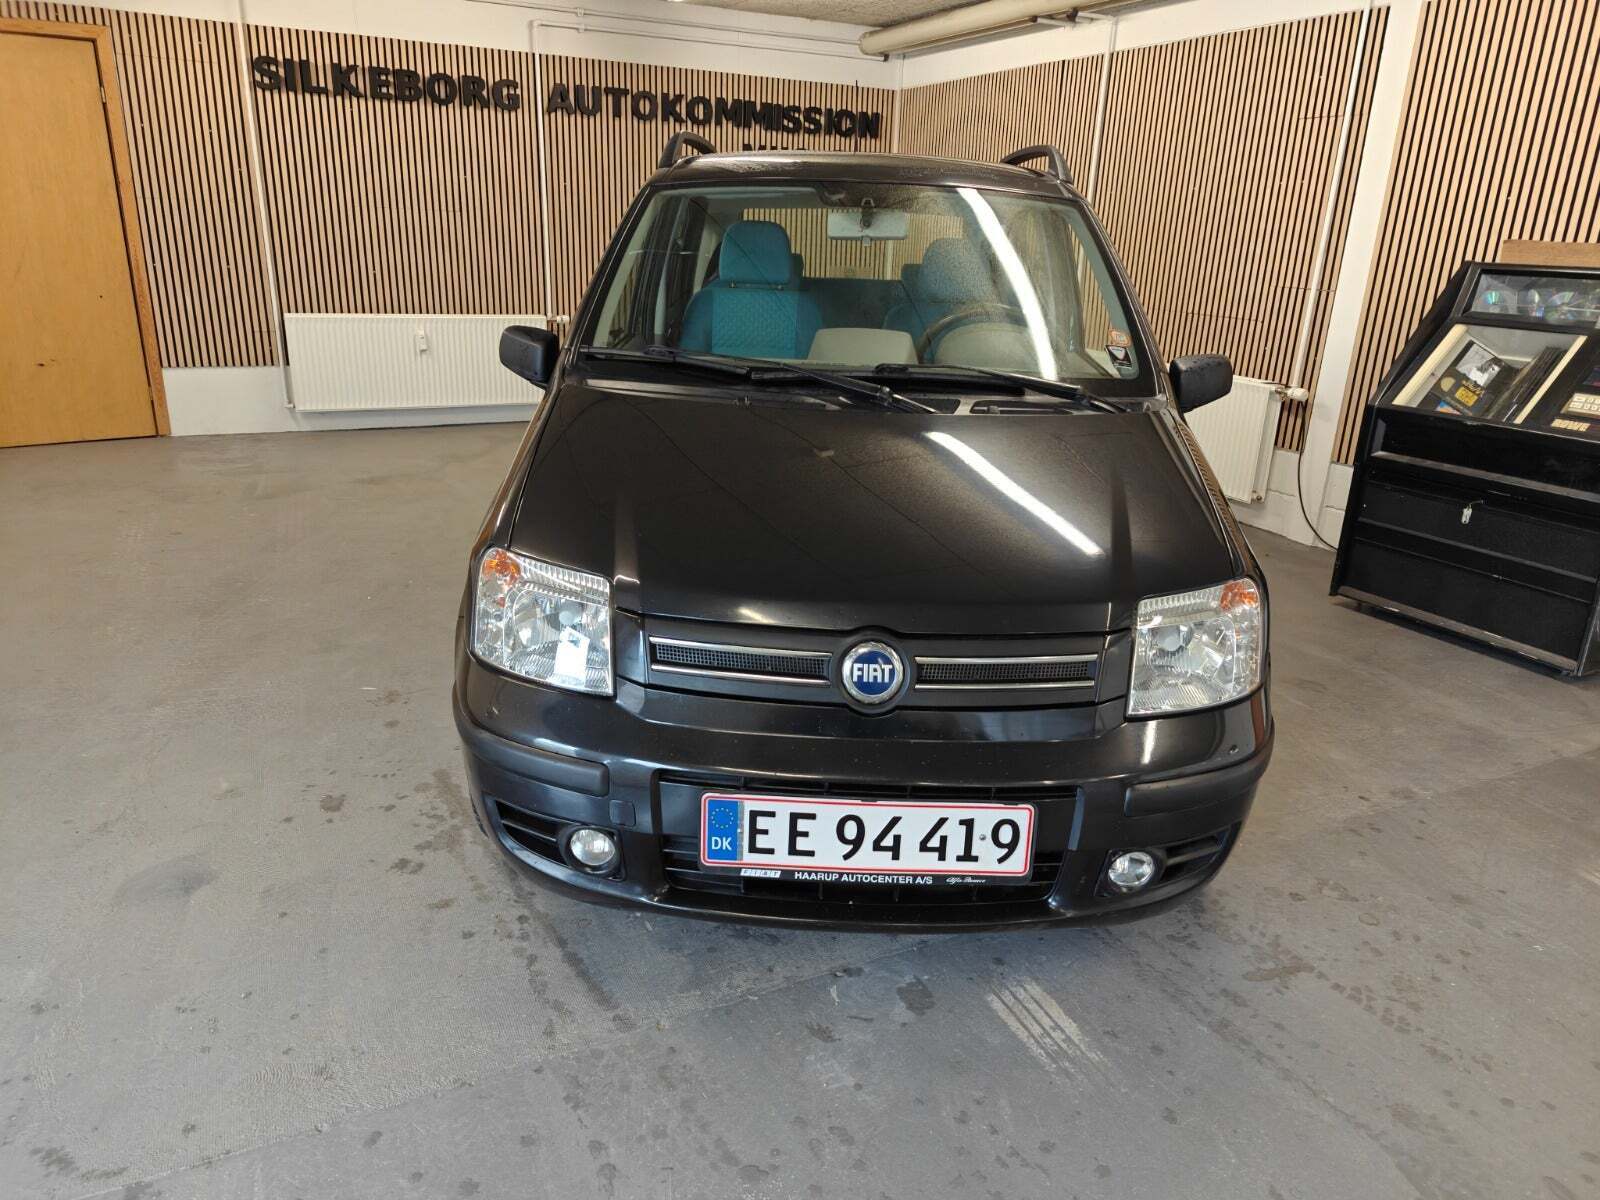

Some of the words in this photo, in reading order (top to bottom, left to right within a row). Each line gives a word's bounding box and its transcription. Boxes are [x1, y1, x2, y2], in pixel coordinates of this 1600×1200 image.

[252, 55, 521, 111] SILKEBORG
[547, 83, 881, 138] AUTOKOMMISSION
[852, 662, 893, 683] FIAT
[711, 836, 732, 850] DK
[747, 809, 817, 857] EE
[835, 813, 903, 862] 94
[918, 816, 1021, 865] 419
[794, 871, 839, 881] HAARUP
[841, 873, 913, 884] AUTOCENTER
[915, 875, 933, 885] A/S
